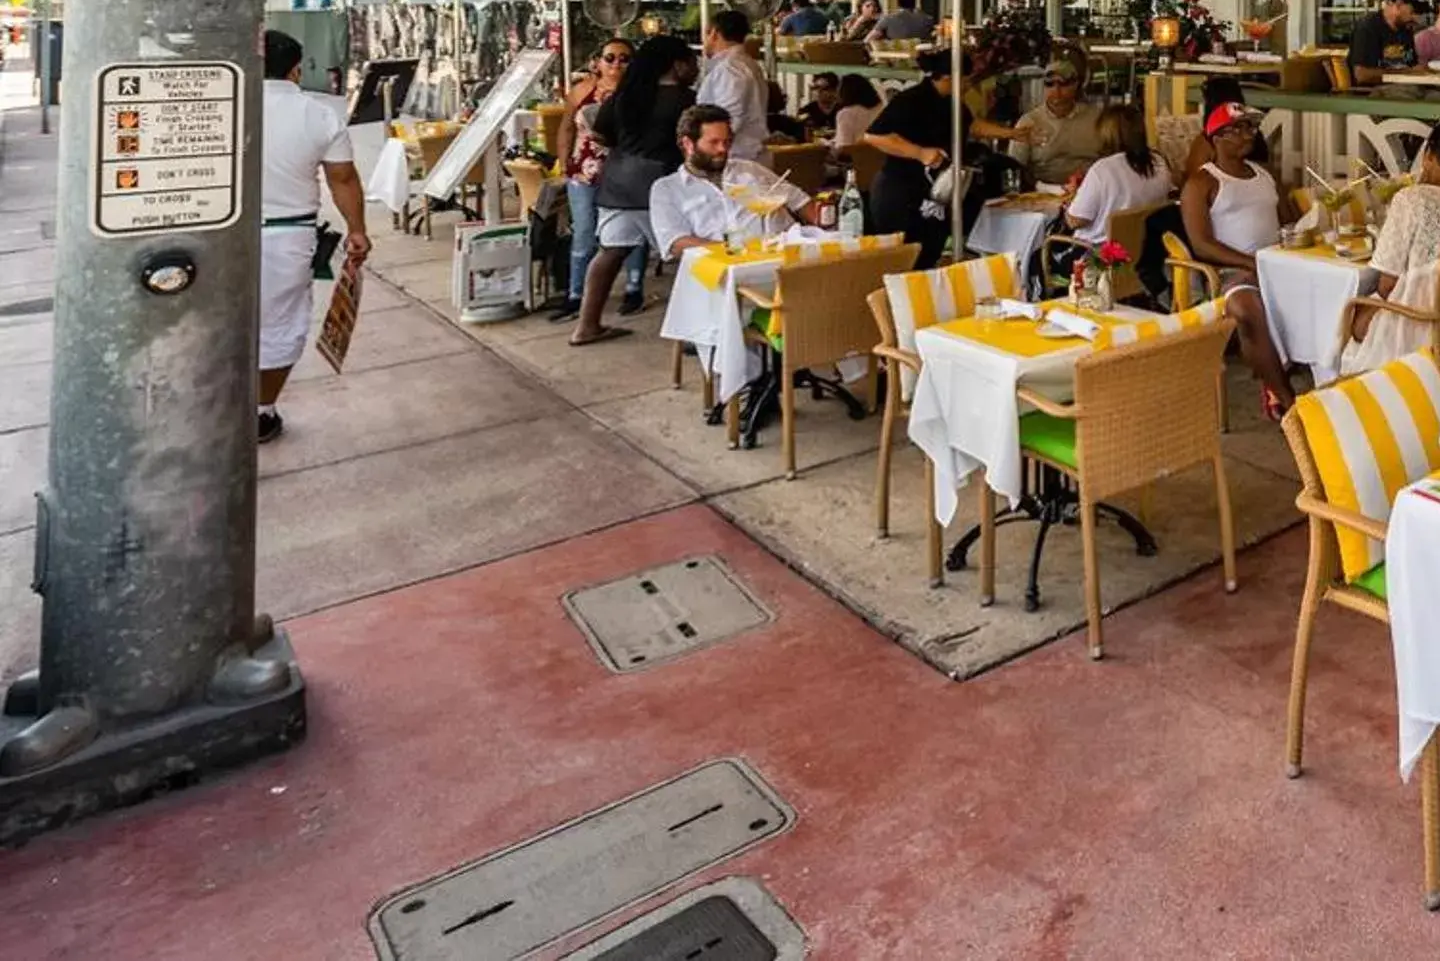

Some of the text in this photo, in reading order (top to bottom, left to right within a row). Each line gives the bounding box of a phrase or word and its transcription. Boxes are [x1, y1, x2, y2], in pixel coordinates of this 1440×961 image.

[143, 196, 156, 205] TO
[159, 195, 191, 204] CROSS
[132, 212, 201, 225] PUSH BUTTON
